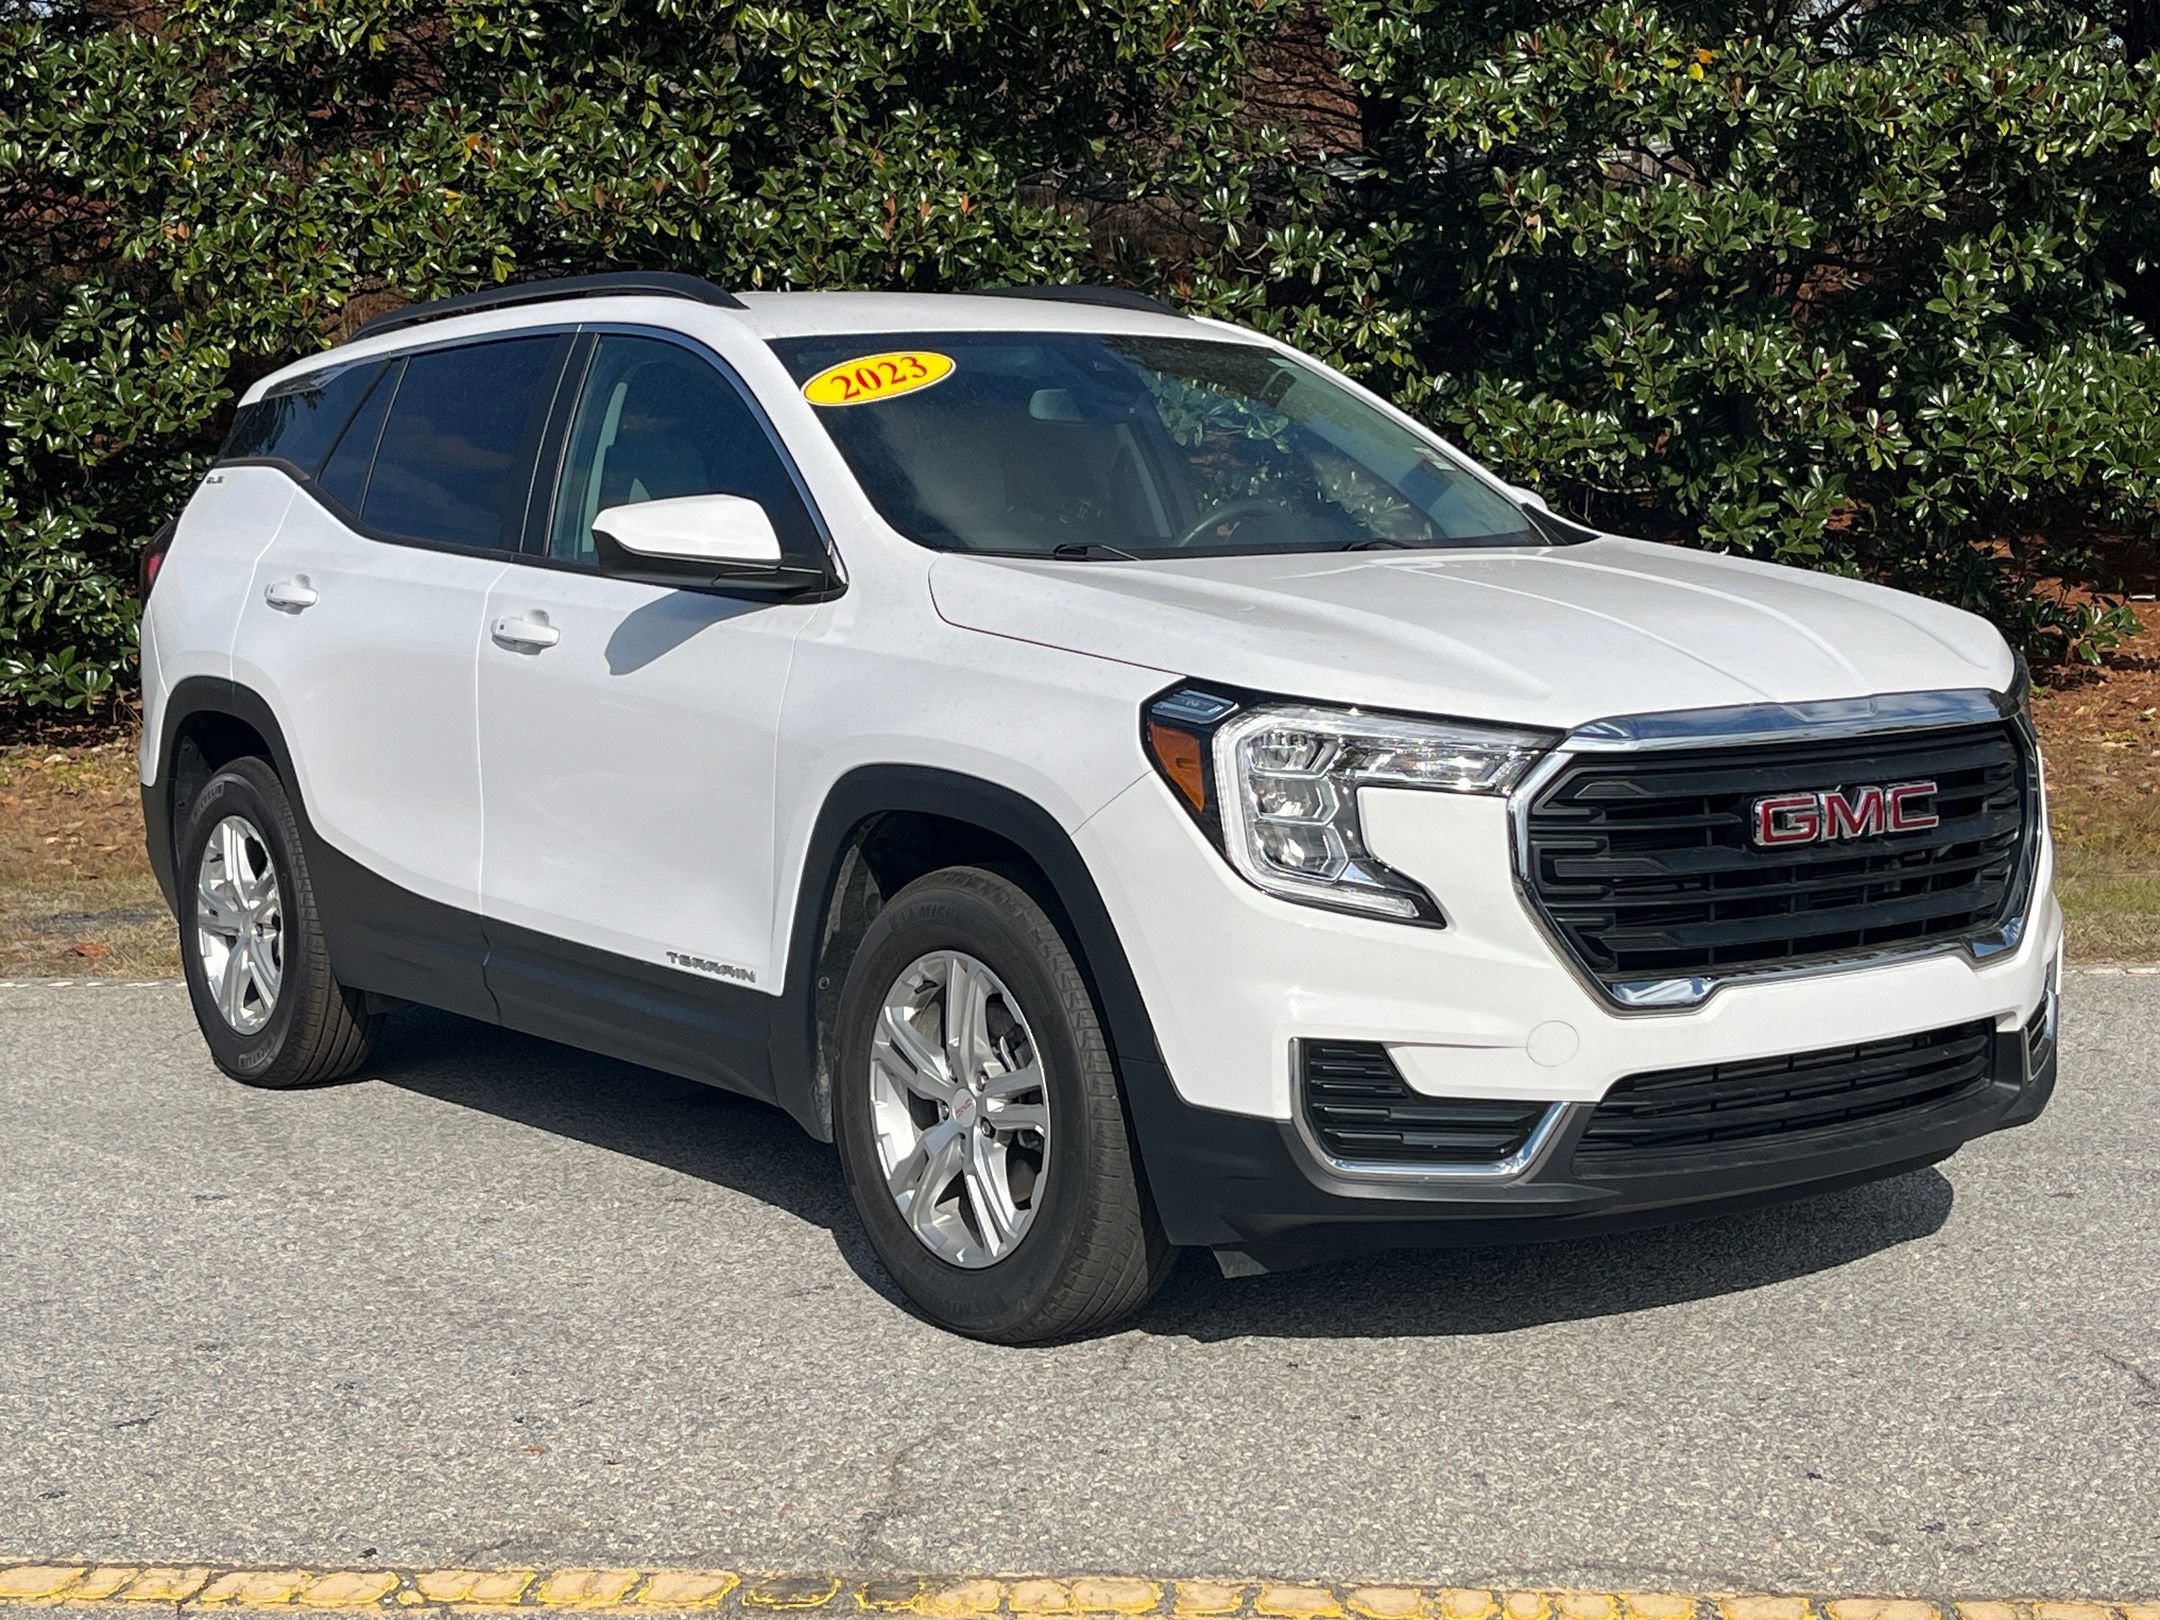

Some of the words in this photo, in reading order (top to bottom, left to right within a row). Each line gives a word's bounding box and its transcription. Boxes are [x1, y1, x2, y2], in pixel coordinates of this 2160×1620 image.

[831, 356, 927, 400] 2023
[1753, 780, 1939, 846] GMC
[666, 951, 756, 983] TERRAIN
